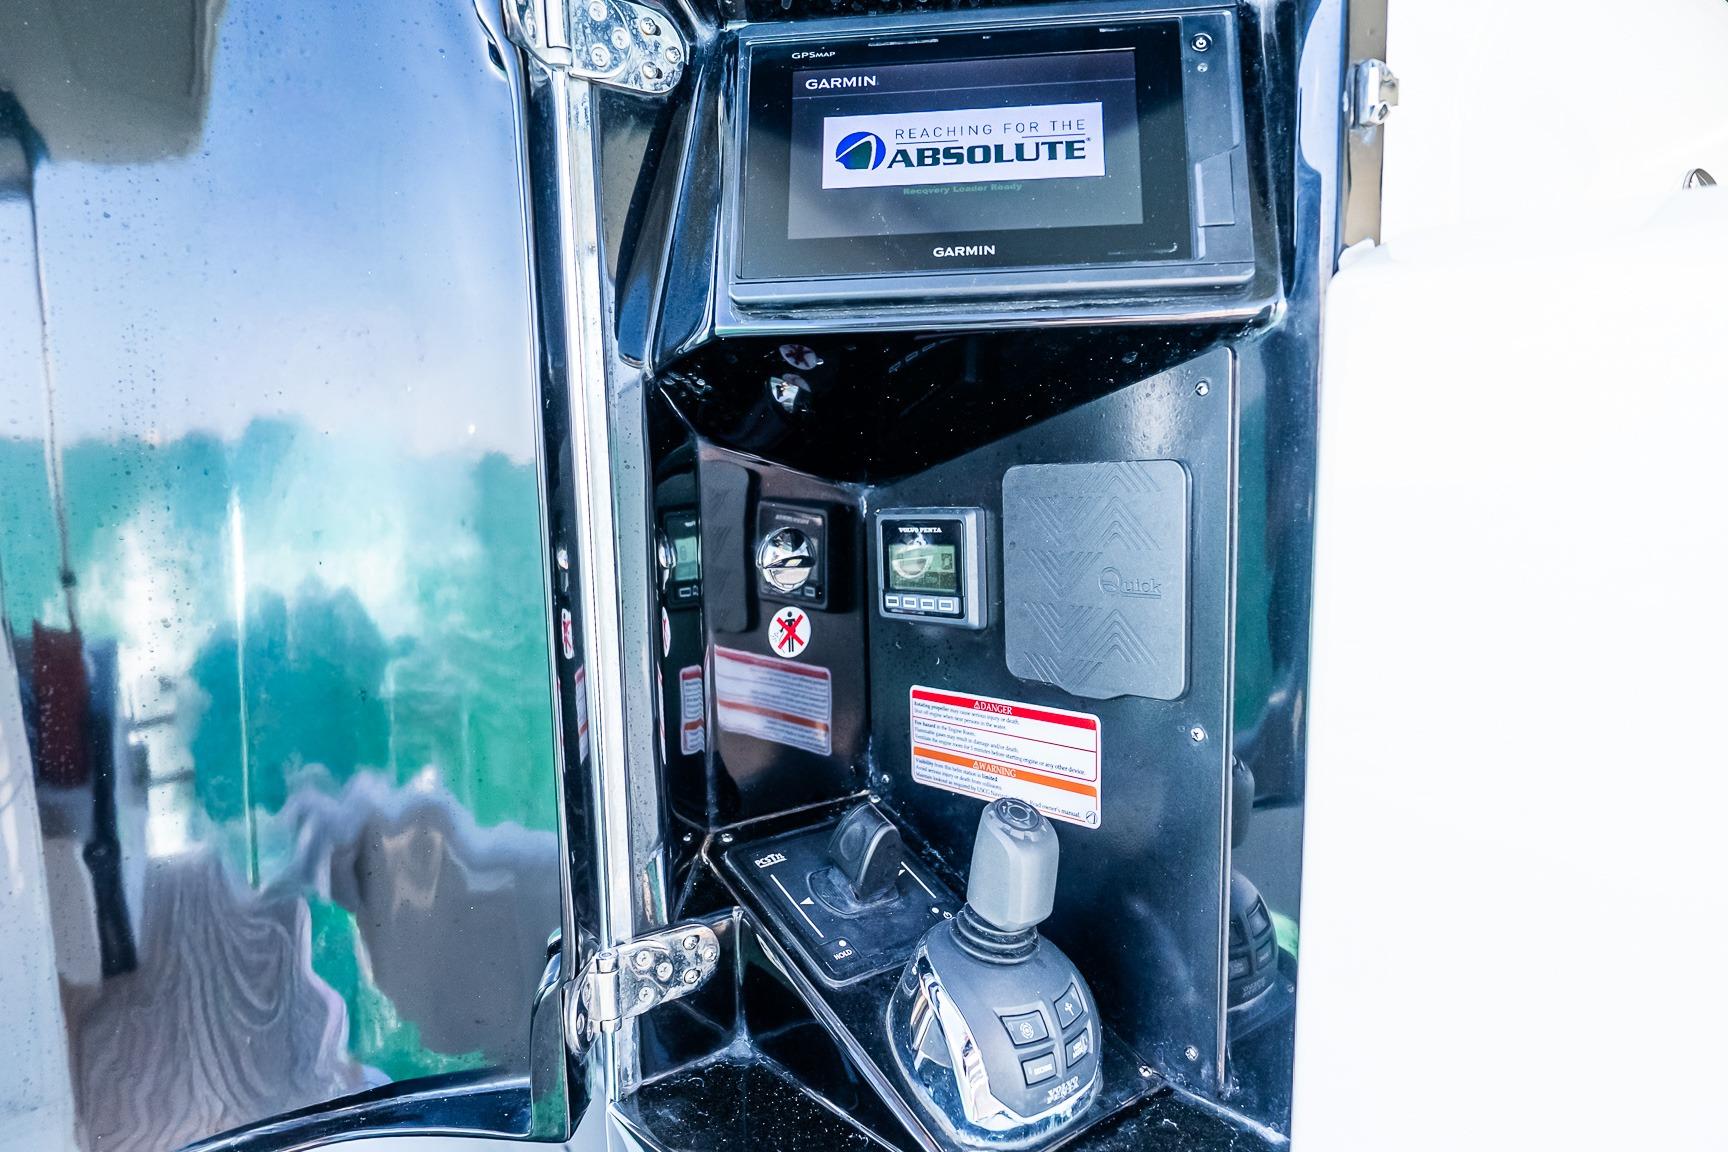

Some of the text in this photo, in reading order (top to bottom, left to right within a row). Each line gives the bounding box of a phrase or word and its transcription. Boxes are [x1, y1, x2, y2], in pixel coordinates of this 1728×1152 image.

[805, 75, 877, 90] GARMIN
[895, 118, 1086, 140] REACHING FOR THE
[887, 140, 1087, 170] ABSOLUTE
[903, 181, 1023, 196] Recovery Loader Ready
[933, 244, 996, 258] GARMIN
[1097, 565, 1162, 598] Quick
[980, 701, 1012, 715] DANGER
[979, 761, 1016, 777] WARNING
[833, 949, 853, 961] HOLD
